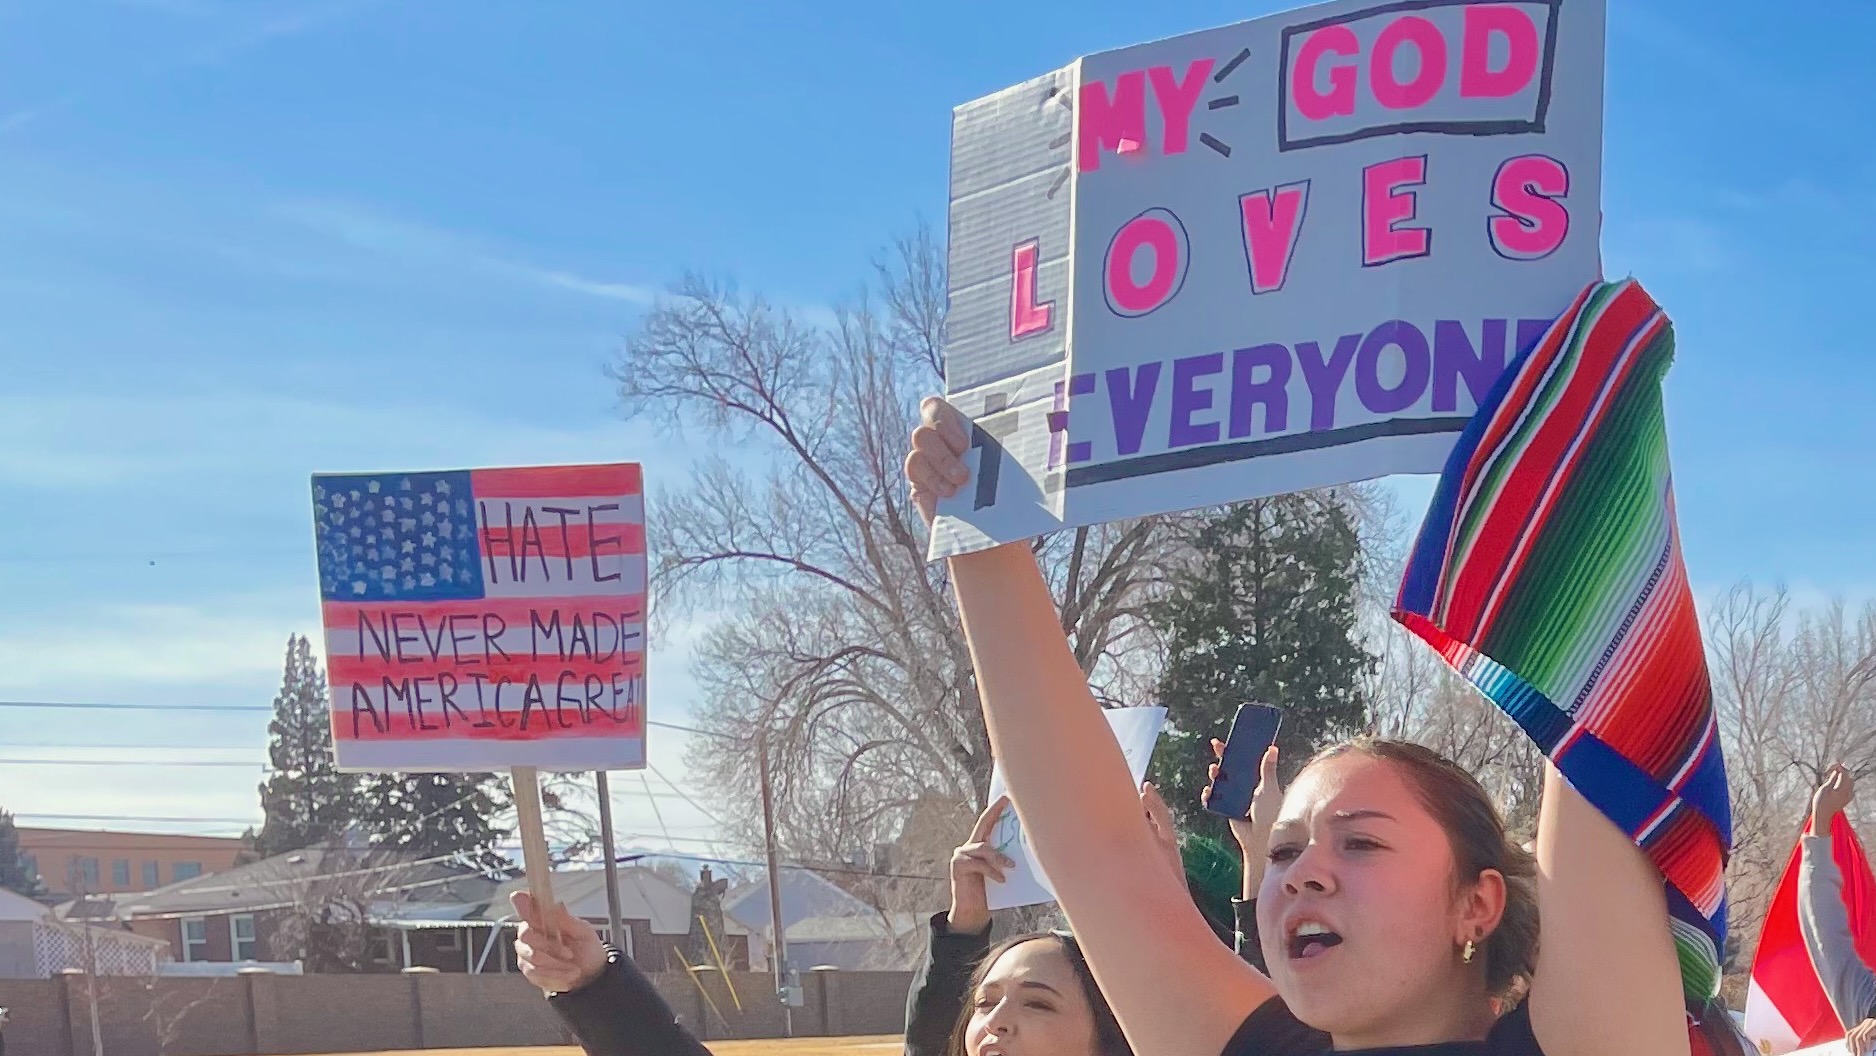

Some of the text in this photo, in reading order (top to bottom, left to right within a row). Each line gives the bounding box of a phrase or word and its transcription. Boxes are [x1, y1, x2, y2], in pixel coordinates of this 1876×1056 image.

[1079, 5, 1540, 173] MY GOD
[1009, 154, 1569, 343] LOVES
[479, 501, 622, 584] HATE
[357, 608, 641, 666] NEVER MADE
